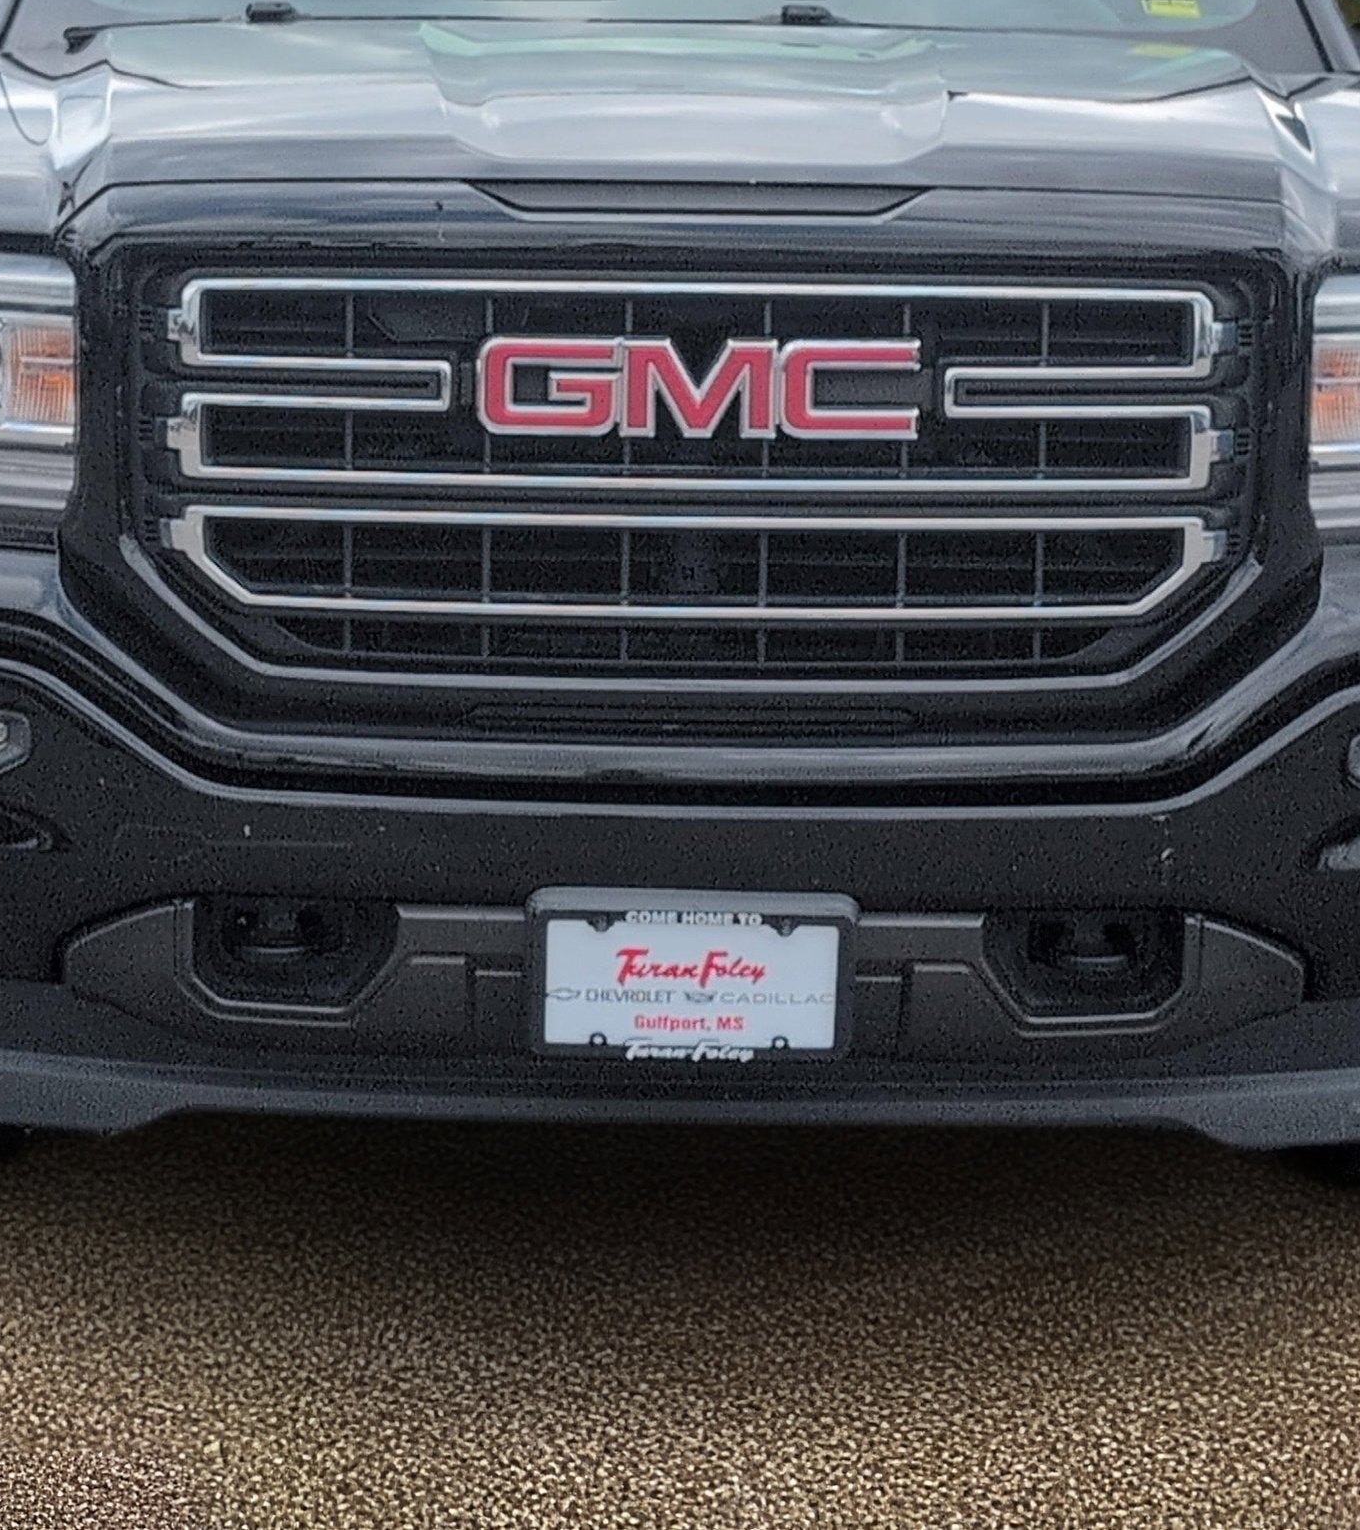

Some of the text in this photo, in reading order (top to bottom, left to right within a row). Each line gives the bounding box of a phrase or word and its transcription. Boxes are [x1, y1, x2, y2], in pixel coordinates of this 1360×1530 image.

[477, 336, 922, 440] GMC
[625, 910, 763, 927] COME HOME TO
[585, 988, 834, 1006] CHEVROLET CADILLAC
[633, 1014, 744, 1032] Gulfport, MS
